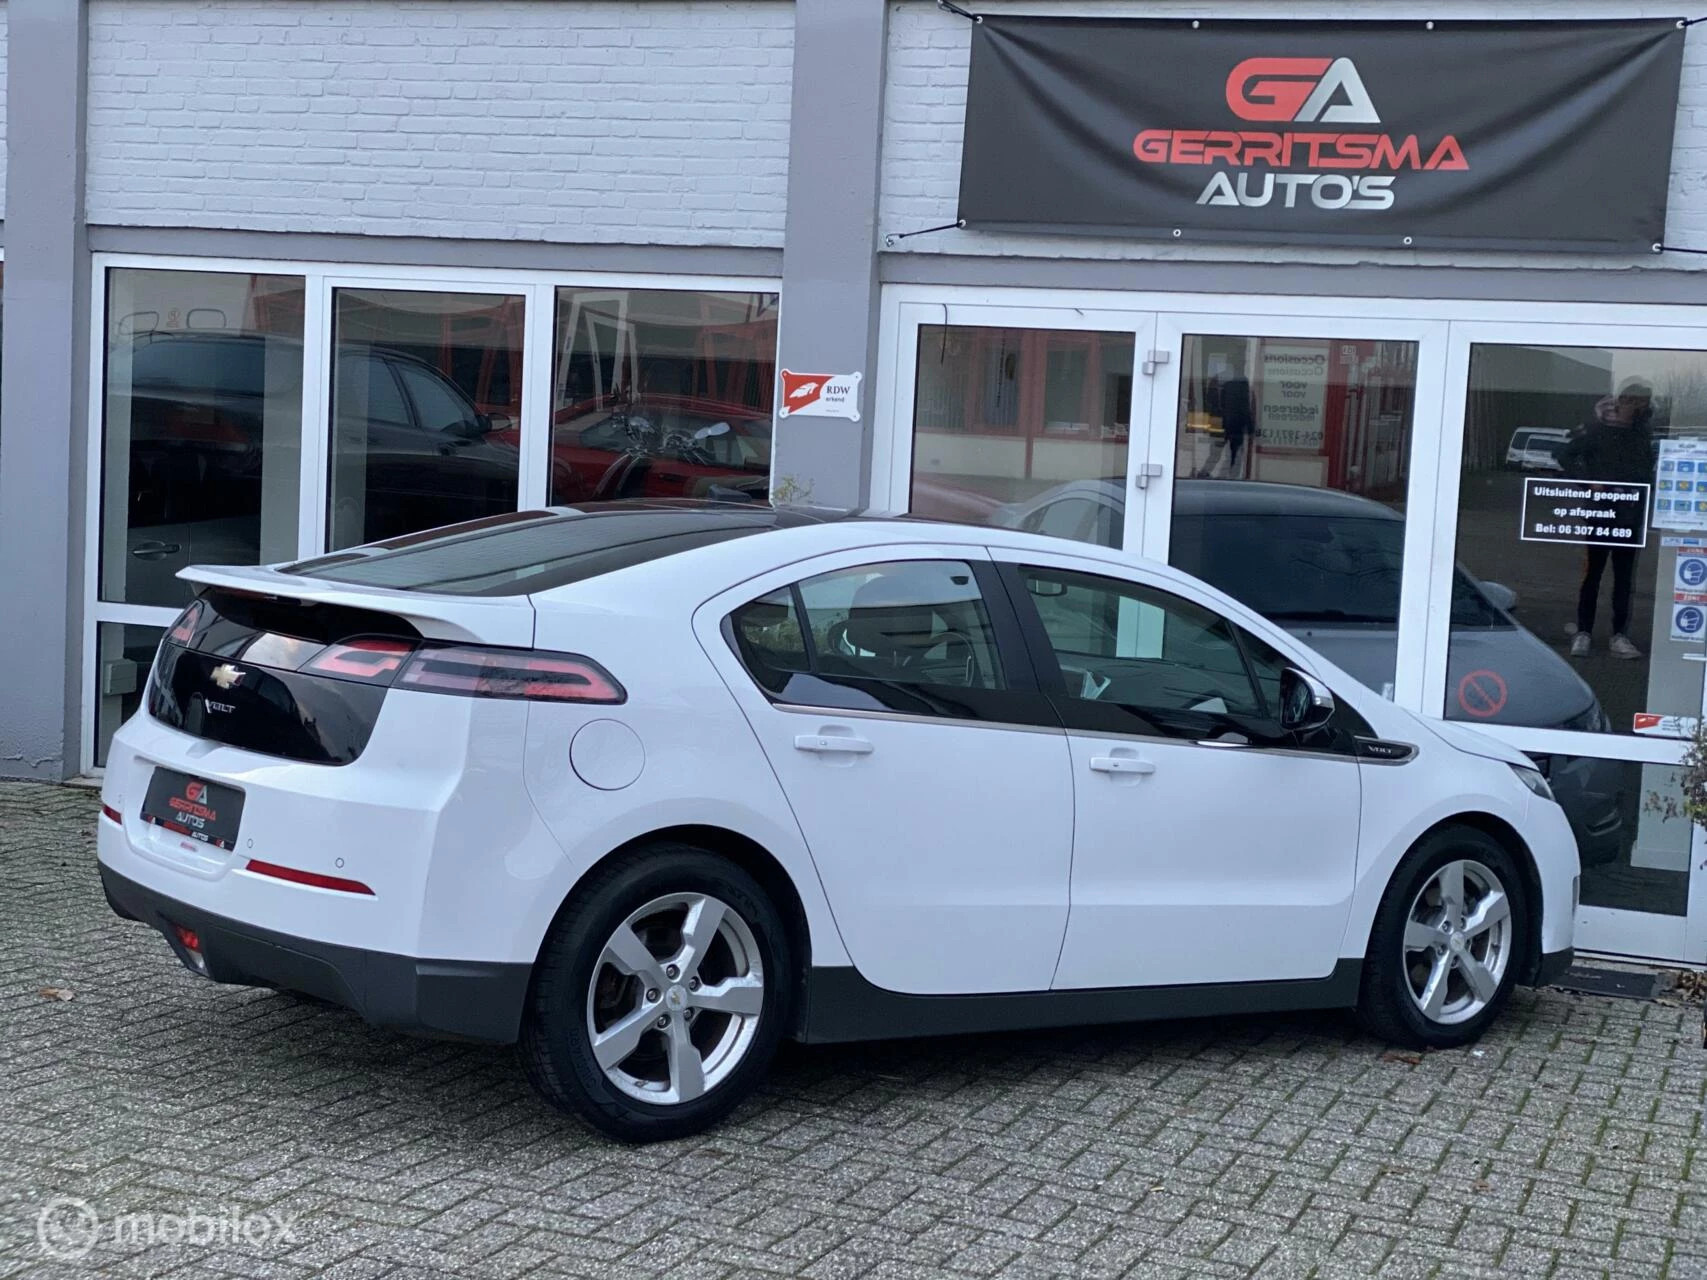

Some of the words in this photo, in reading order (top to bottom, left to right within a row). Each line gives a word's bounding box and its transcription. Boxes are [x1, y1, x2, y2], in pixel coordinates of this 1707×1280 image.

[1226, 57, 1380, 123] GA
[1133, 129, 1470, 170] GERRITSMA
[1196, 171, 1395, 210] AUTO'S
[826, 385, 851, 395] RDW
[1534, 487, 1591, 498] Uitsluitend
[1594, 491, 1640, 502] geopend
[1554, 508, 1567, 518] op
[1569, 507, 1616, 519] afspraak
[1535, 523, 1556, 533] Bel:
[1558, 525, 1572, 534] 06
[1574, 525, 1594, 536] 307
[1596, 527, 1610, 536] 84
[1612, 528, 1633, 538] 689
[205, 698, 236, 714] VOLT
[186, 781, 208, 805] GA
